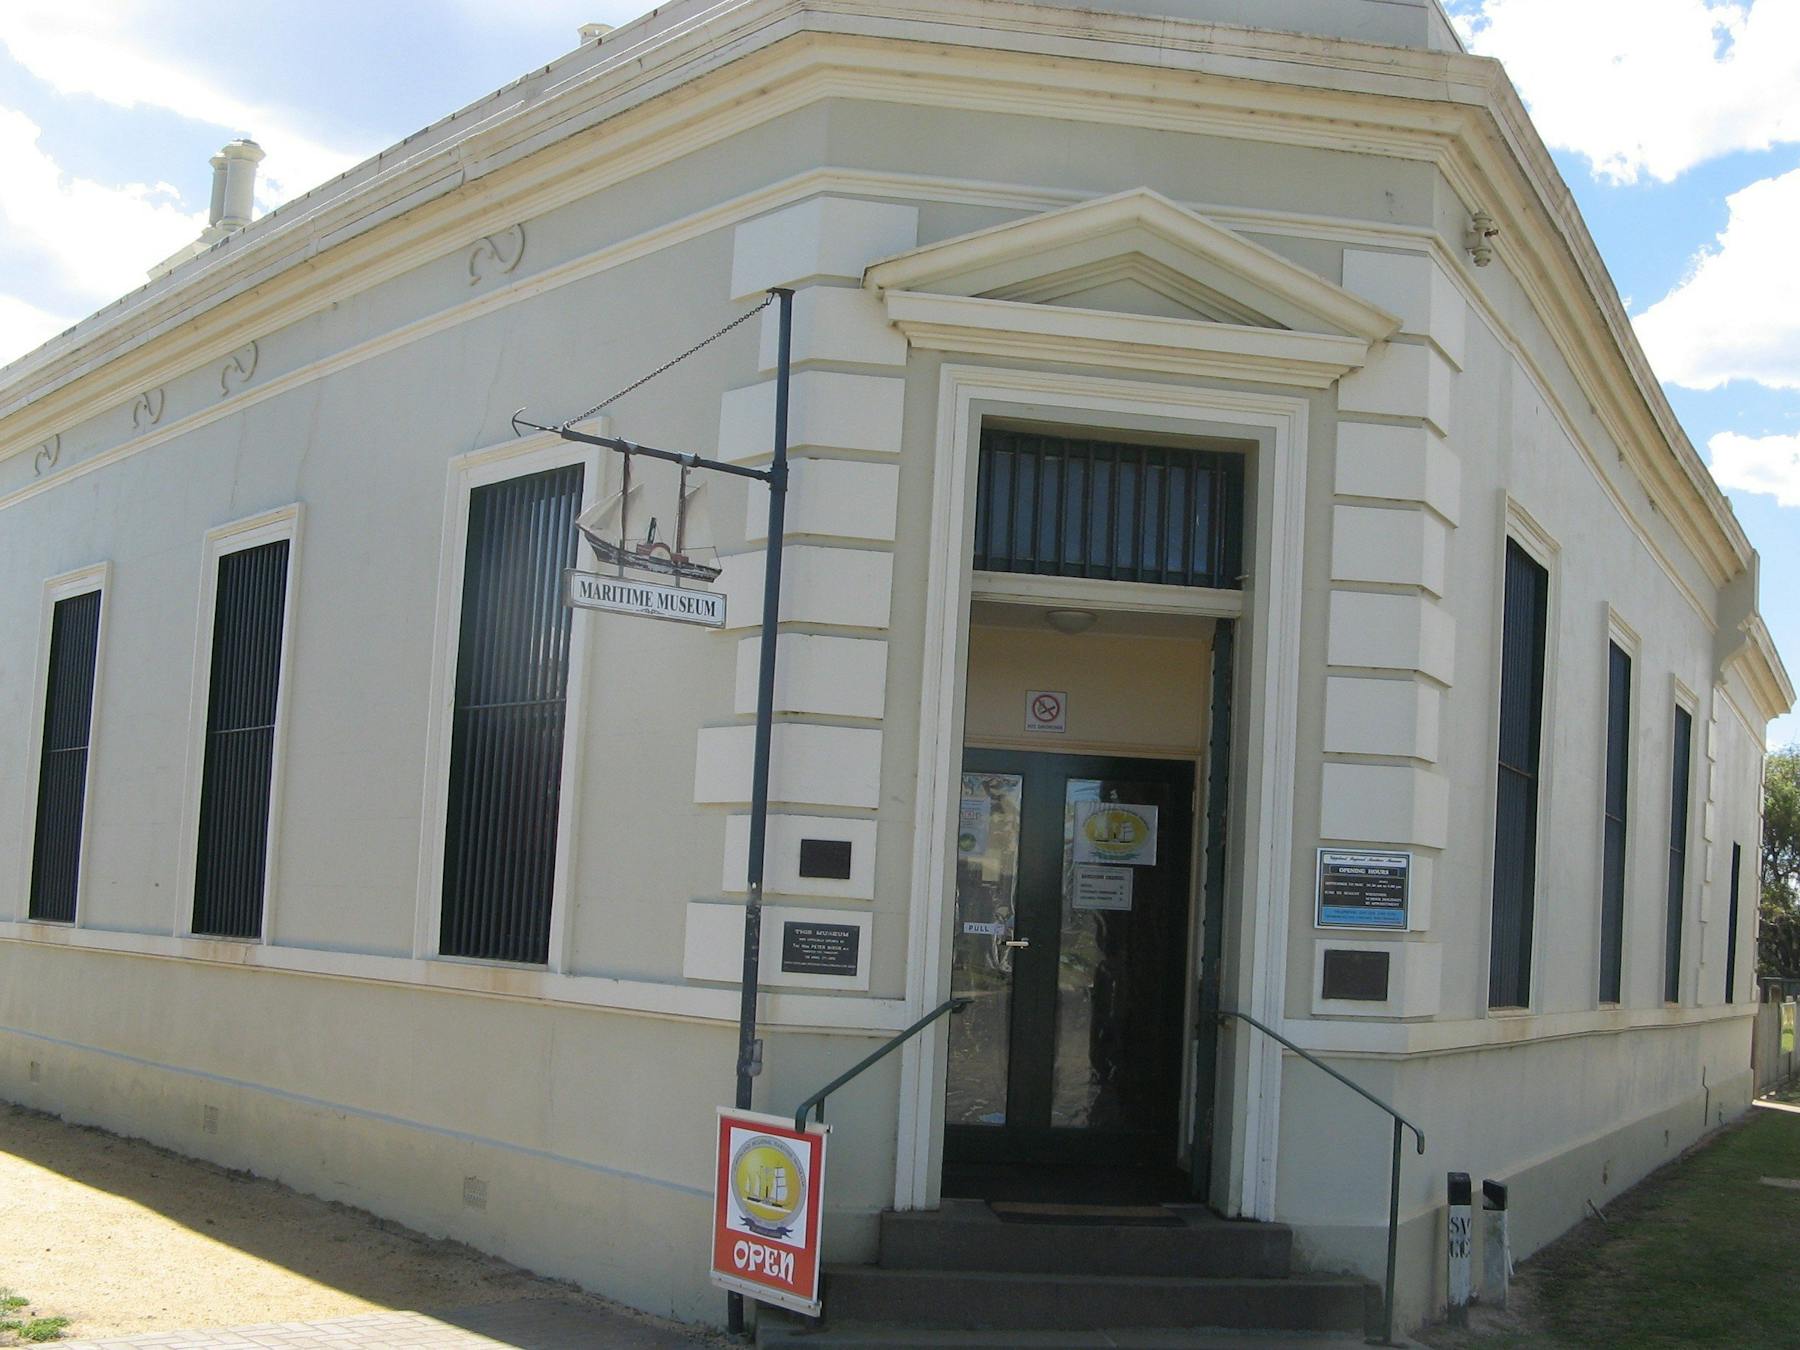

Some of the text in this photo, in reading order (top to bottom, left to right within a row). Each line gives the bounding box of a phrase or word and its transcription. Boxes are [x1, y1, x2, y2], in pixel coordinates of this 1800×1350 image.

[580, 580, 716, 617] MARITIME MUSEUM
[968, 924, 990, 932] PULL
[733, 1240, 794, 1285] OPEN
